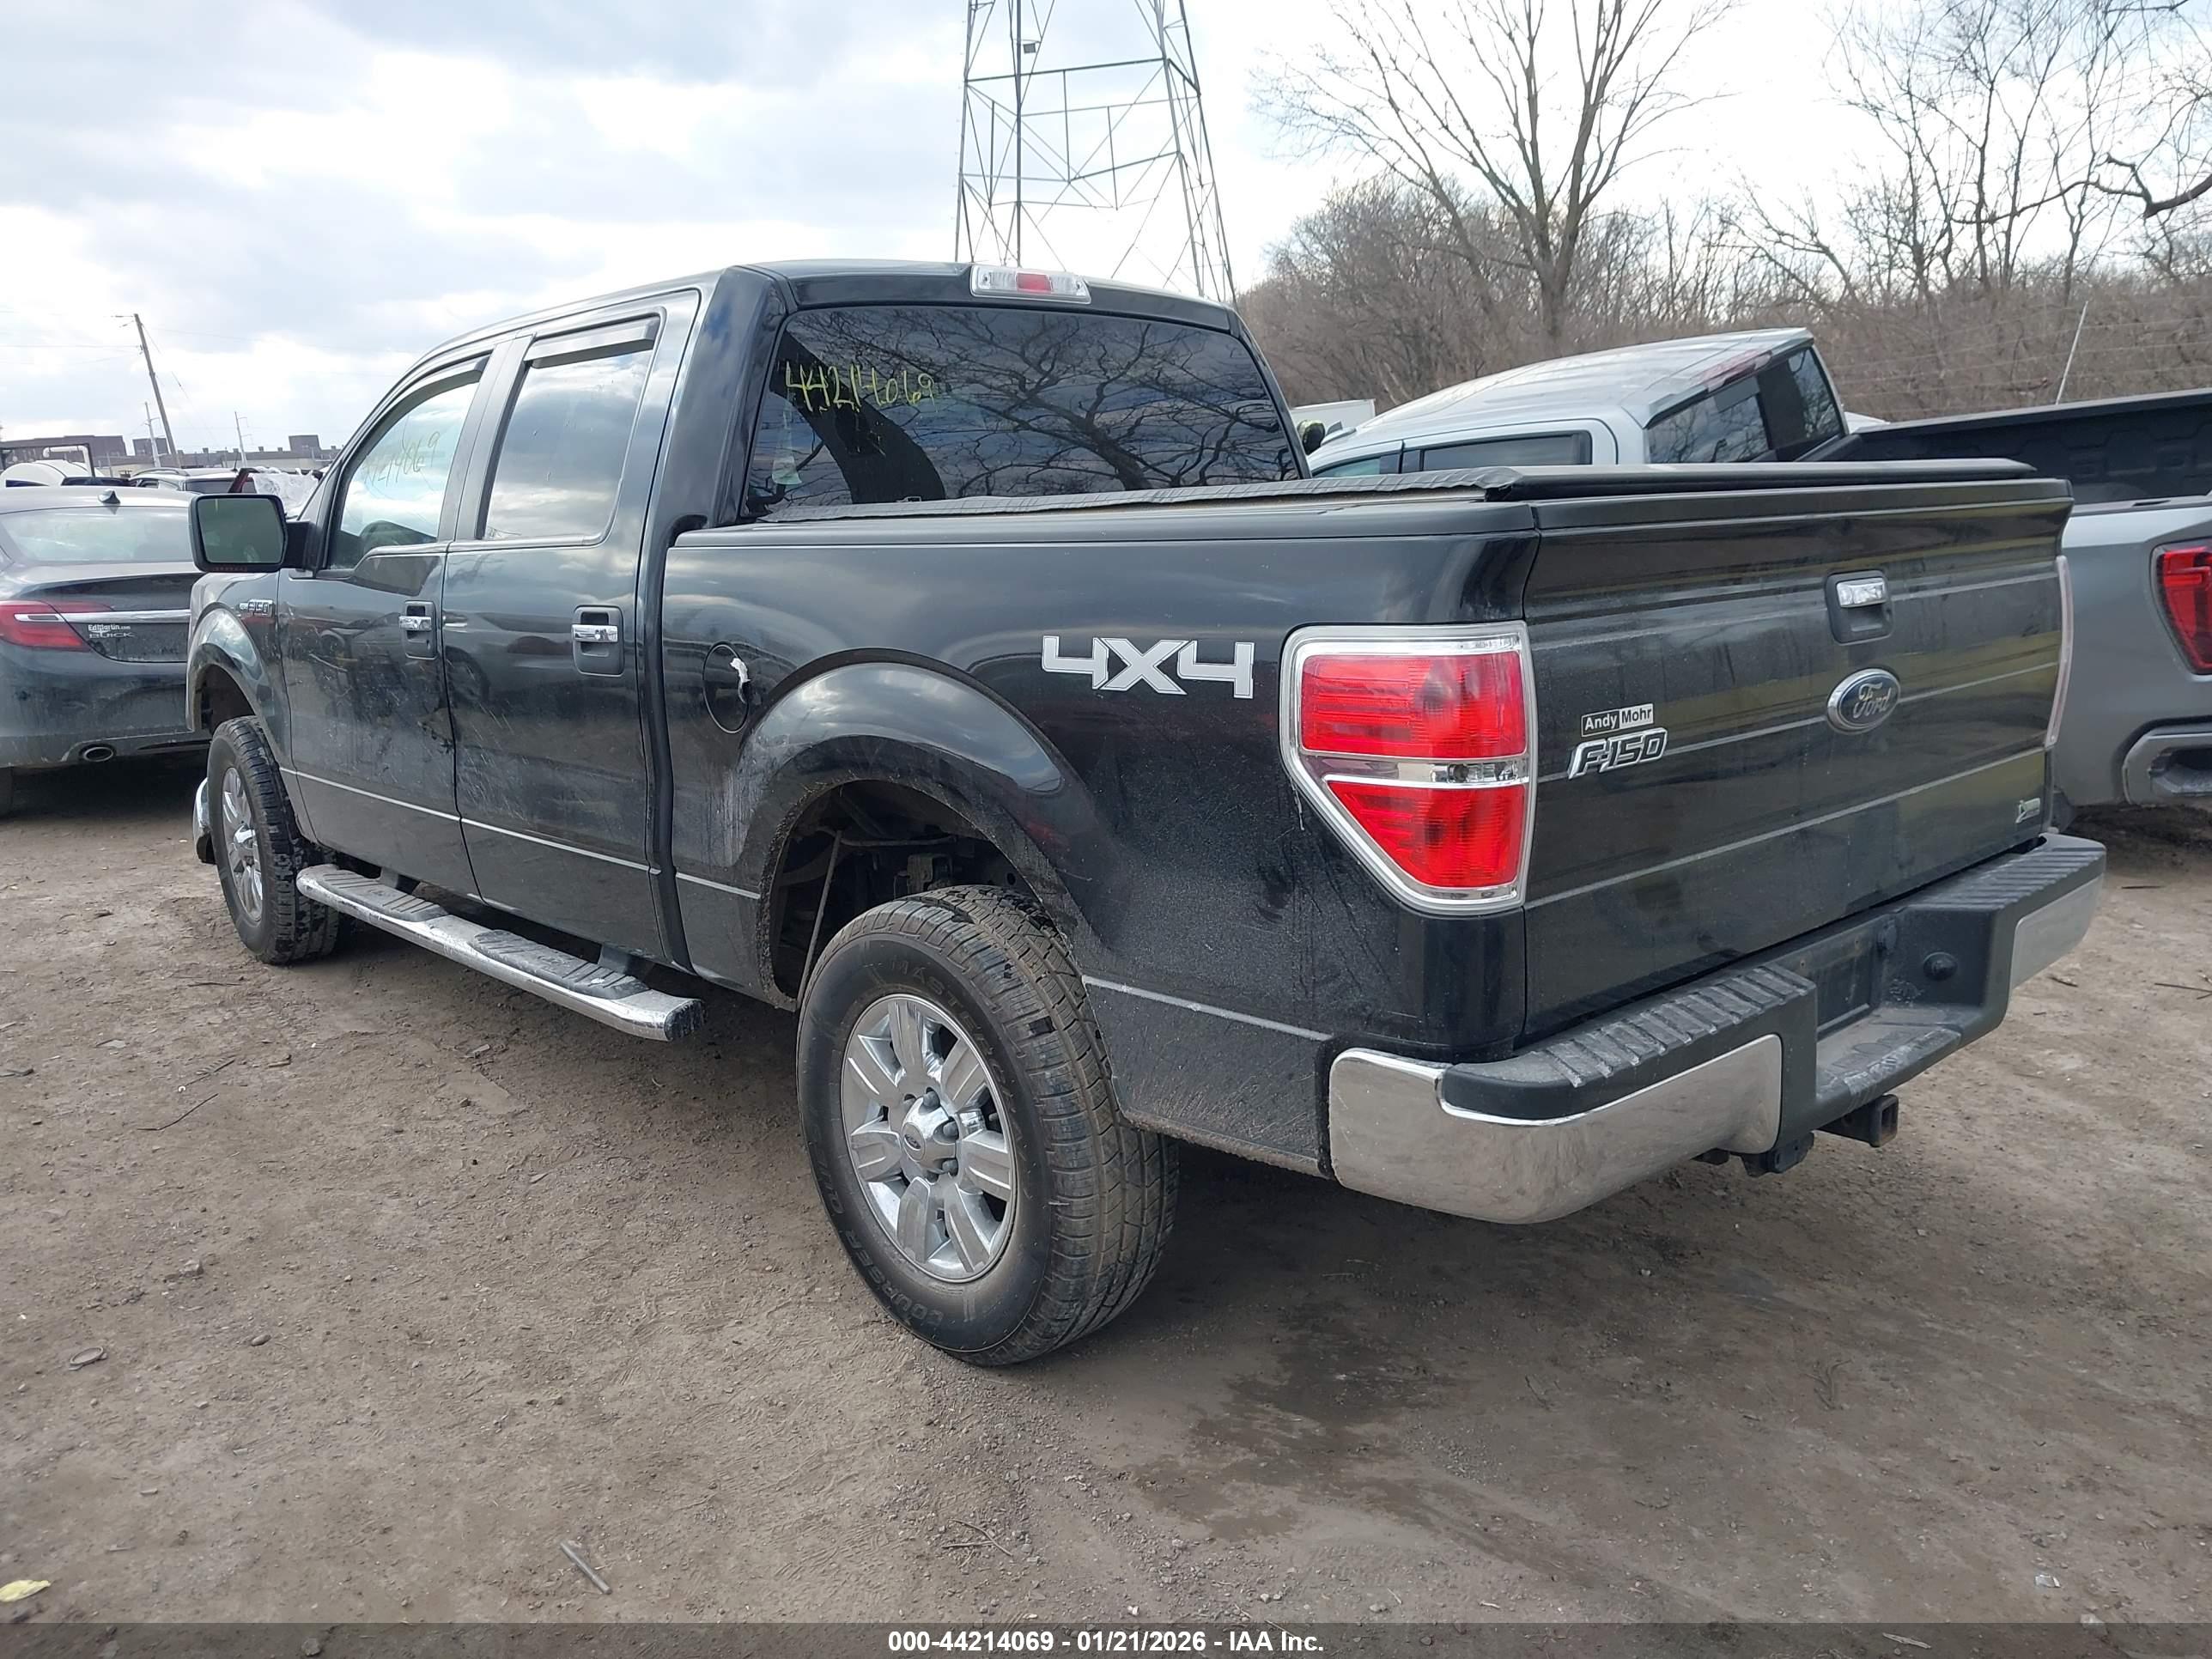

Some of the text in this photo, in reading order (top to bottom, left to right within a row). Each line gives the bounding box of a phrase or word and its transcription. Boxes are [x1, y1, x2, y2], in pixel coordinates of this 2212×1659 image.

[785, 361, 938, 412] 44214069
[1584, 707, 1652, 731] Andy Mohr
[1852, 682, 1893, 719] Ford
